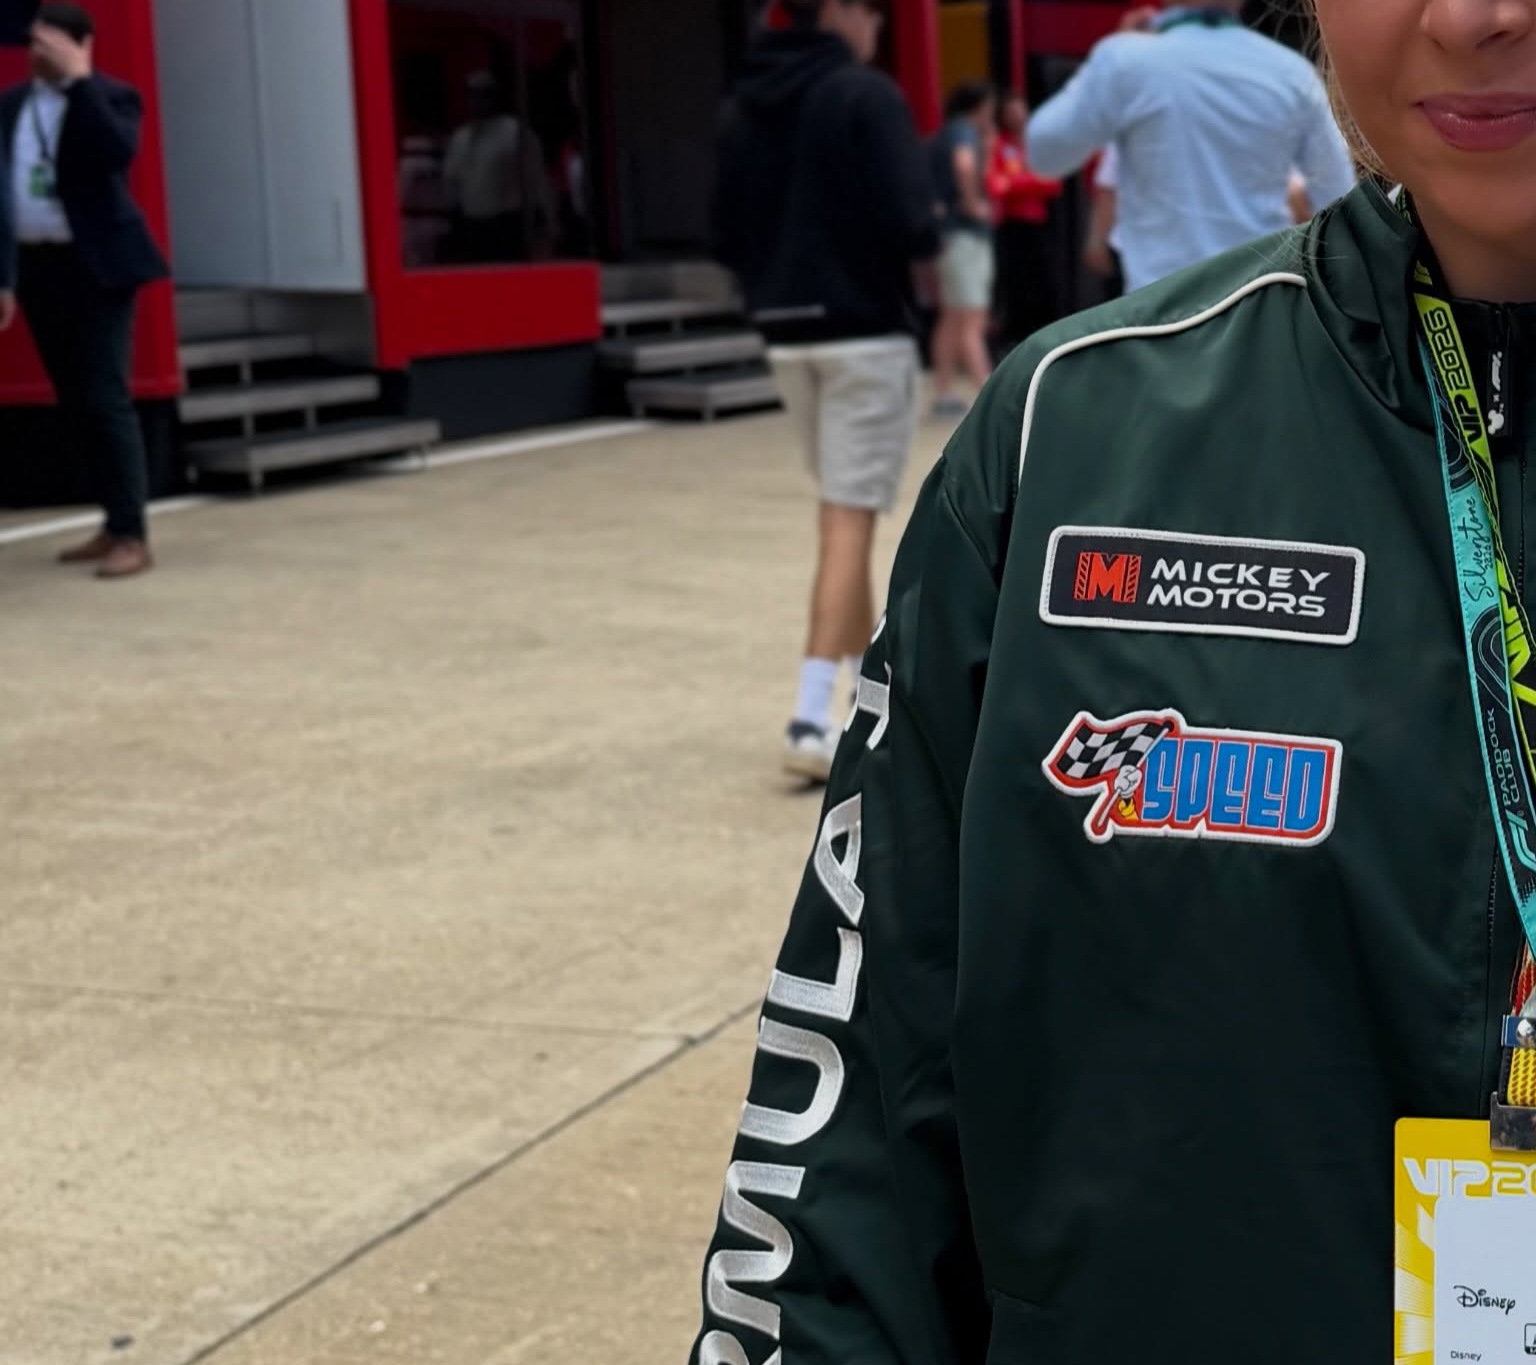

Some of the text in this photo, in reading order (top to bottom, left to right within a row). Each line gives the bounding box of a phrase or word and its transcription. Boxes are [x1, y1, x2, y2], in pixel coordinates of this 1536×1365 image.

[1423, 305, 1483, 444] VIP 2026
[1150, 558, 1331, 593] MICKEY
[1459, 496, 1495, 603] Silverstone
[1146, 585, 1327, 618] MOTORS
[1142, 738, 1328, 833] SPEED
[1487, 707, 1512, 807] PADDOCK
[1502, 748, 1521, 804] CLUB
[1450, 1350, 1482, 1362] Disney
